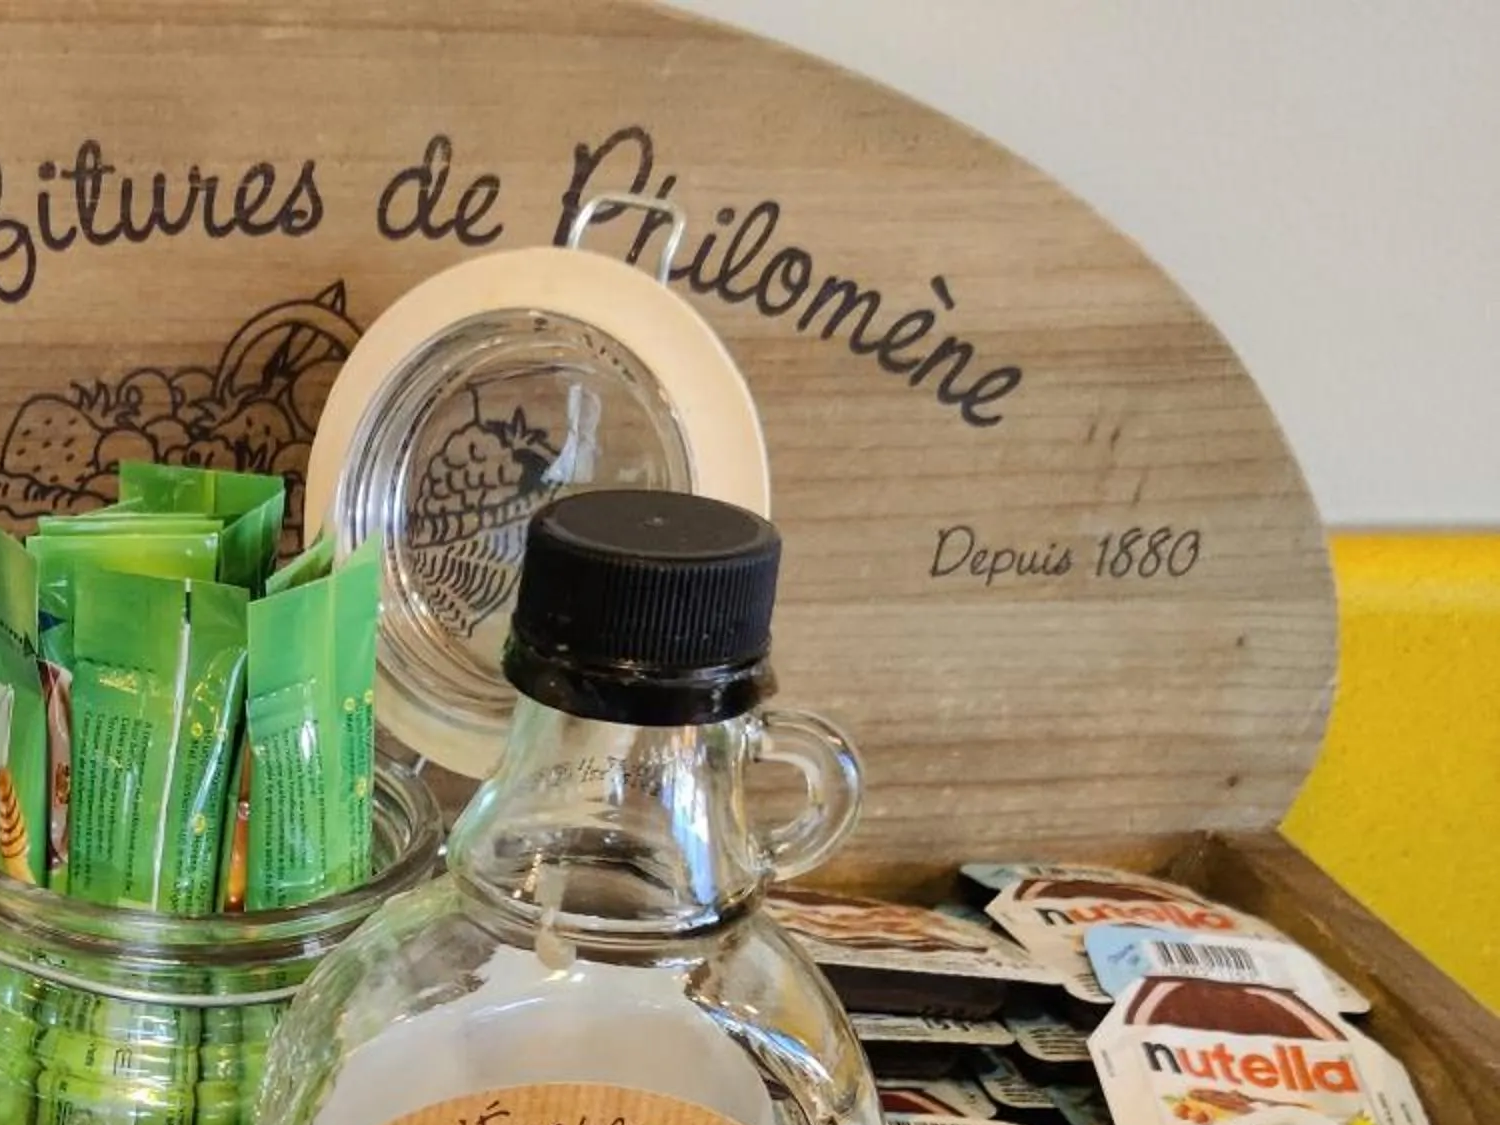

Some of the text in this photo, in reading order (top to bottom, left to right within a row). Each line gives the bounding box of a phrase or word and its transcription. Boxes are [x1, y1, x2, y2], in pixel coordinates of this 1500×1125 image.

[377, 134, 504, 246] de
[553, 126, 1022, 428] Philomène
[930, 525, 1201, 587] Depuis 1880
[1142, 1038, 1361, 1095] nutella
